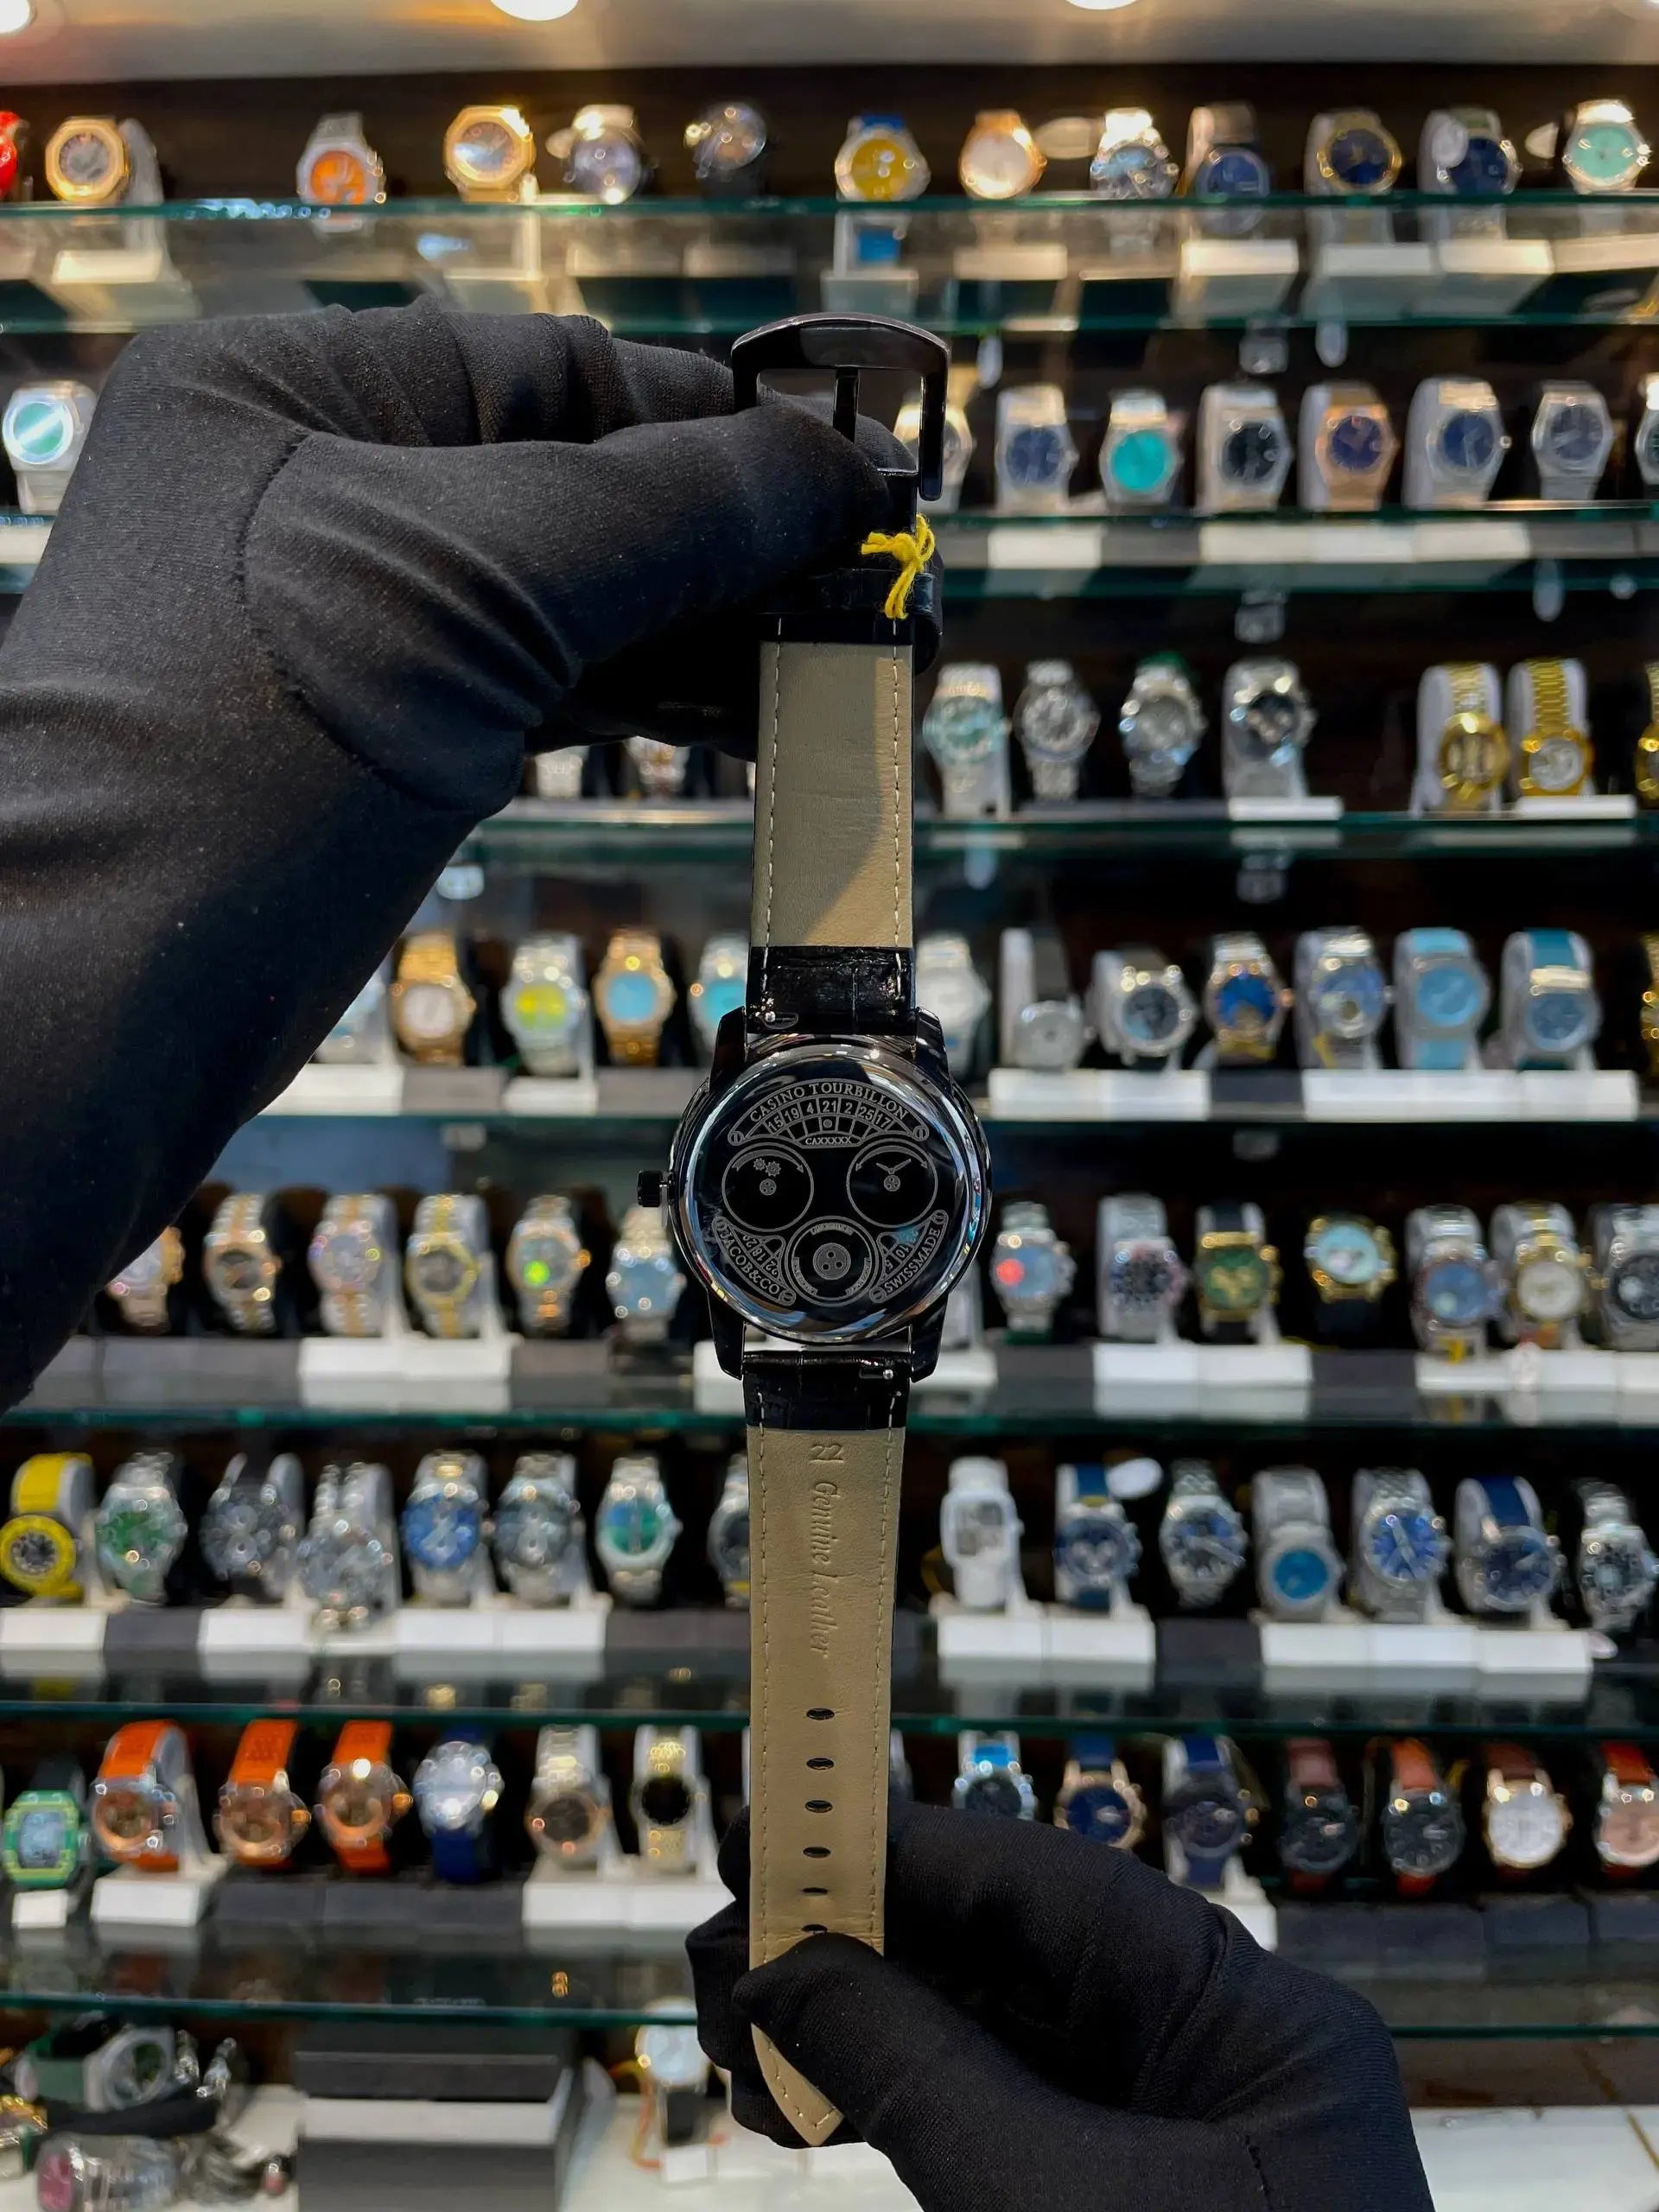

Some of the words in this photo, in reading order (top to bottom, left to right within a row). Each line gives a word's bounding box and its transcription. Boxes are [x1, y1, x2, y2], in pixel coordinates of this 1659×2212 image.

[750, 1087, 804, 1122] CASINO
[810, 1082, 907, 1122] TOURBILLON
[768, 1116, 784, 1132] 15
[785, 1109, 799, 1122] 19
[806, 1103, 814, 1114] 4
[823, 1100, 836, 1113] 21
[845, 1102, 853, 1114] 2
[860, 1106, 874, 1121] 25
[875, 1113, 891, 1127] 17
[805, 1136, 852, 1145] CAXXXXX
[810, 1444, 843, 1463] 22
[810, 1482, 841, 1564] Genuine
[810, 1571, 839, 1657] Leather
